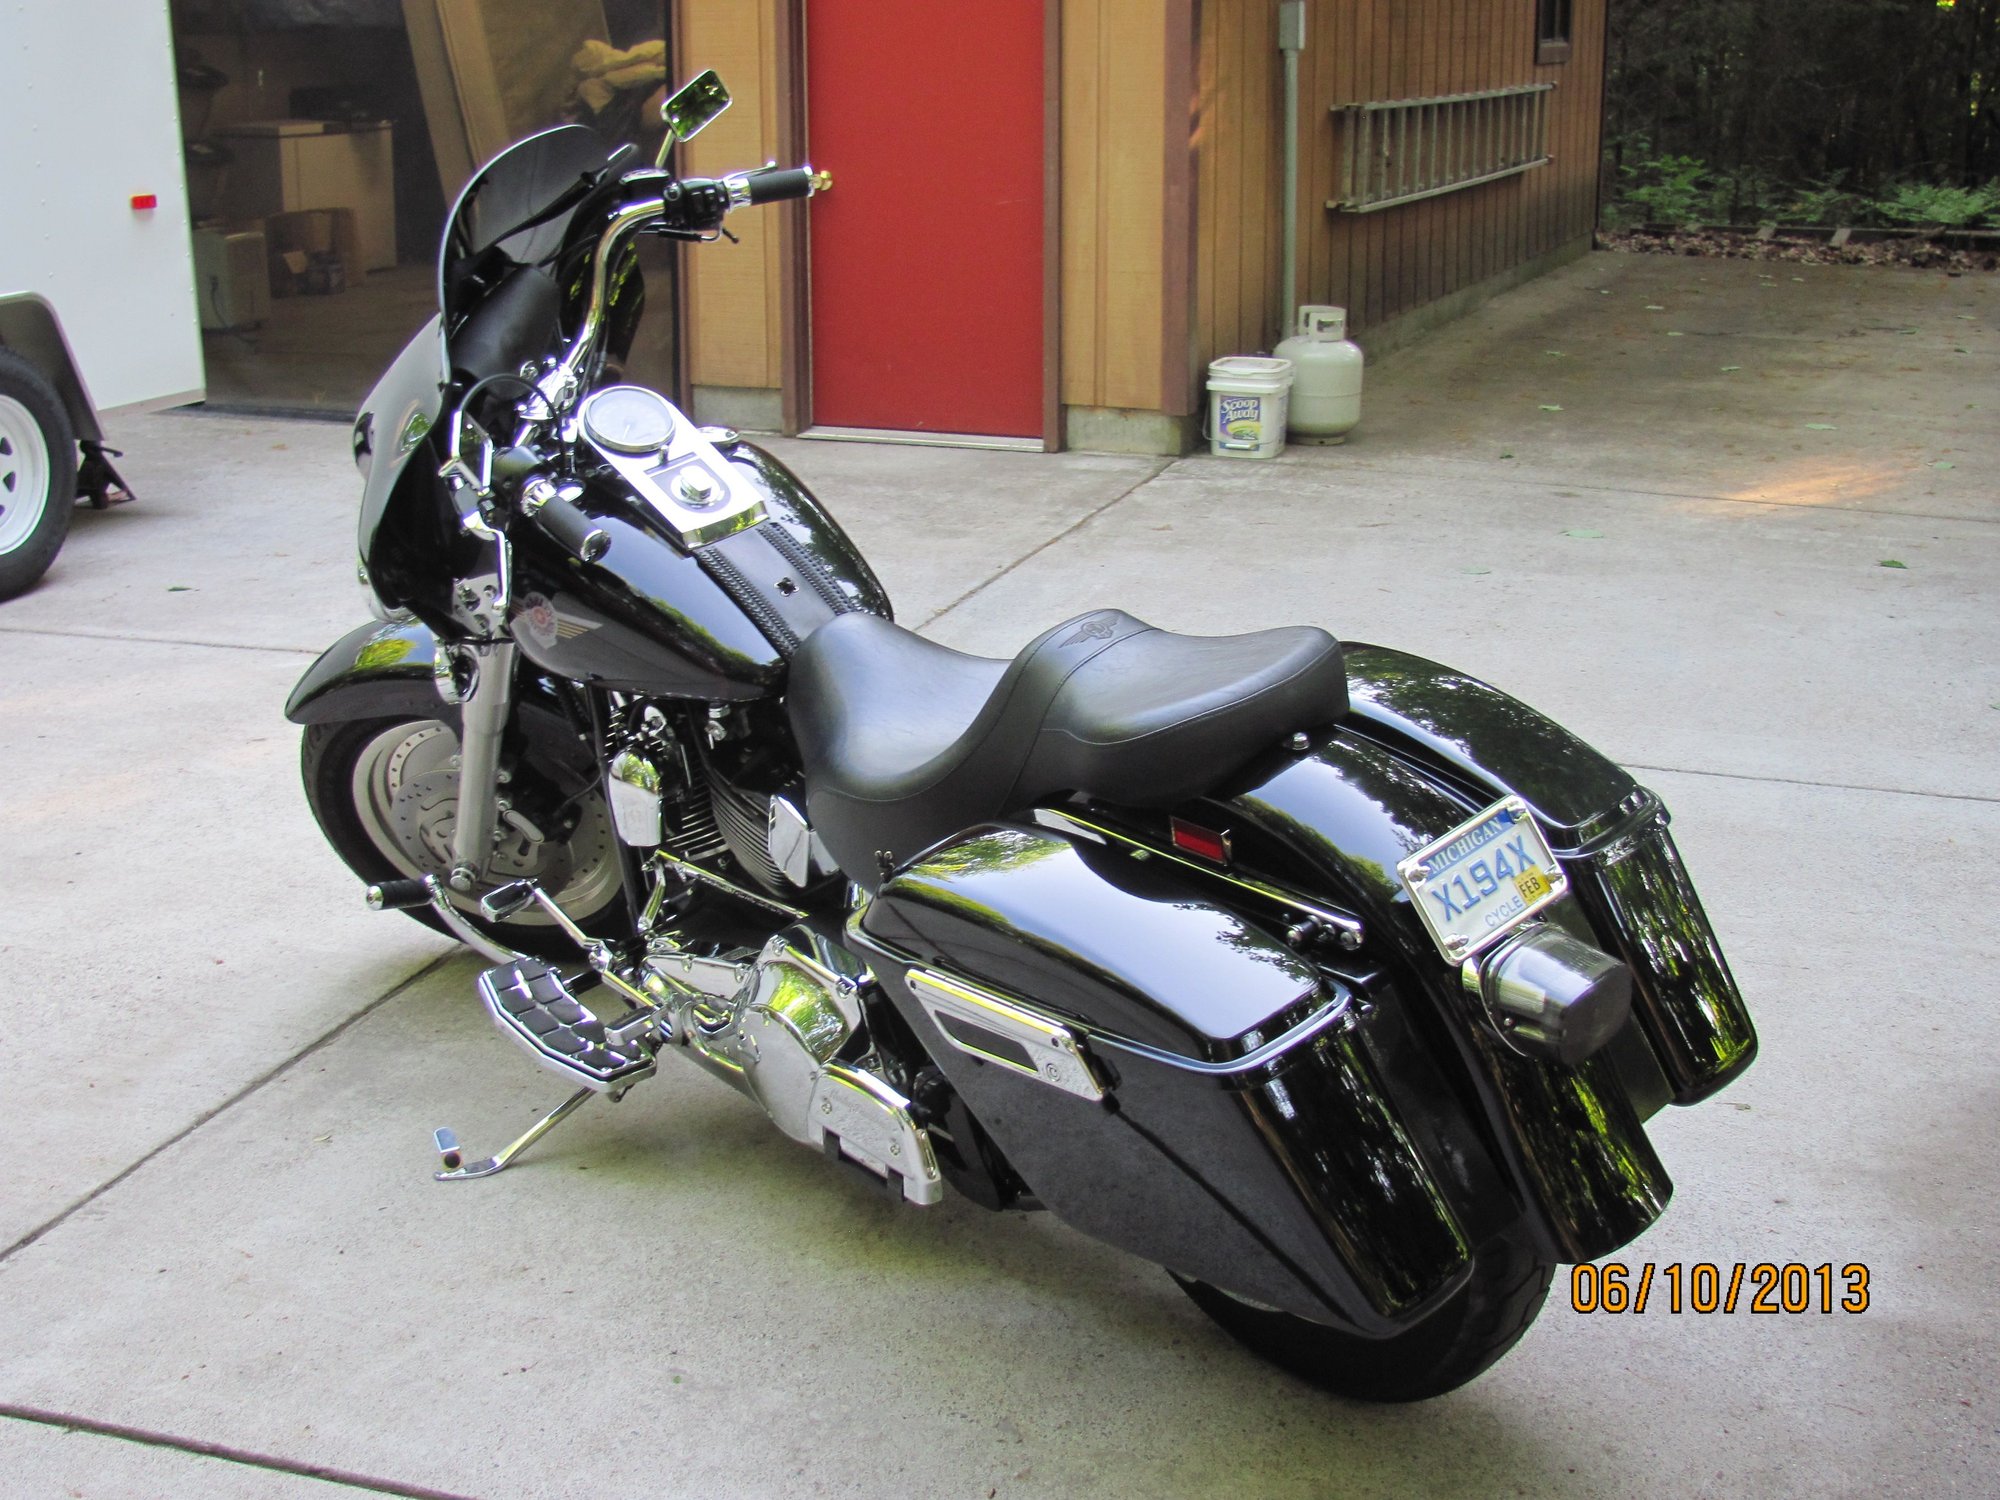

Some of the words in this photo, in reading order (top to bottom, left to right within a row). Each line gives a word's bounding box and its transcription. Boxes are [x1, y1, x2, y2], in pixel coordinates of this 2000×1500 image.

[1221, 399, 1258, 414] Scoop
[1222, 409, 1258, 423] Away
[1429, 818, 1503, 874] MICHIGAN
[1431, 835, 1536, 921] X194X
[1519, 876, 1540, 898] FEB
[1485, 895, 1523, 927] CYCLE
